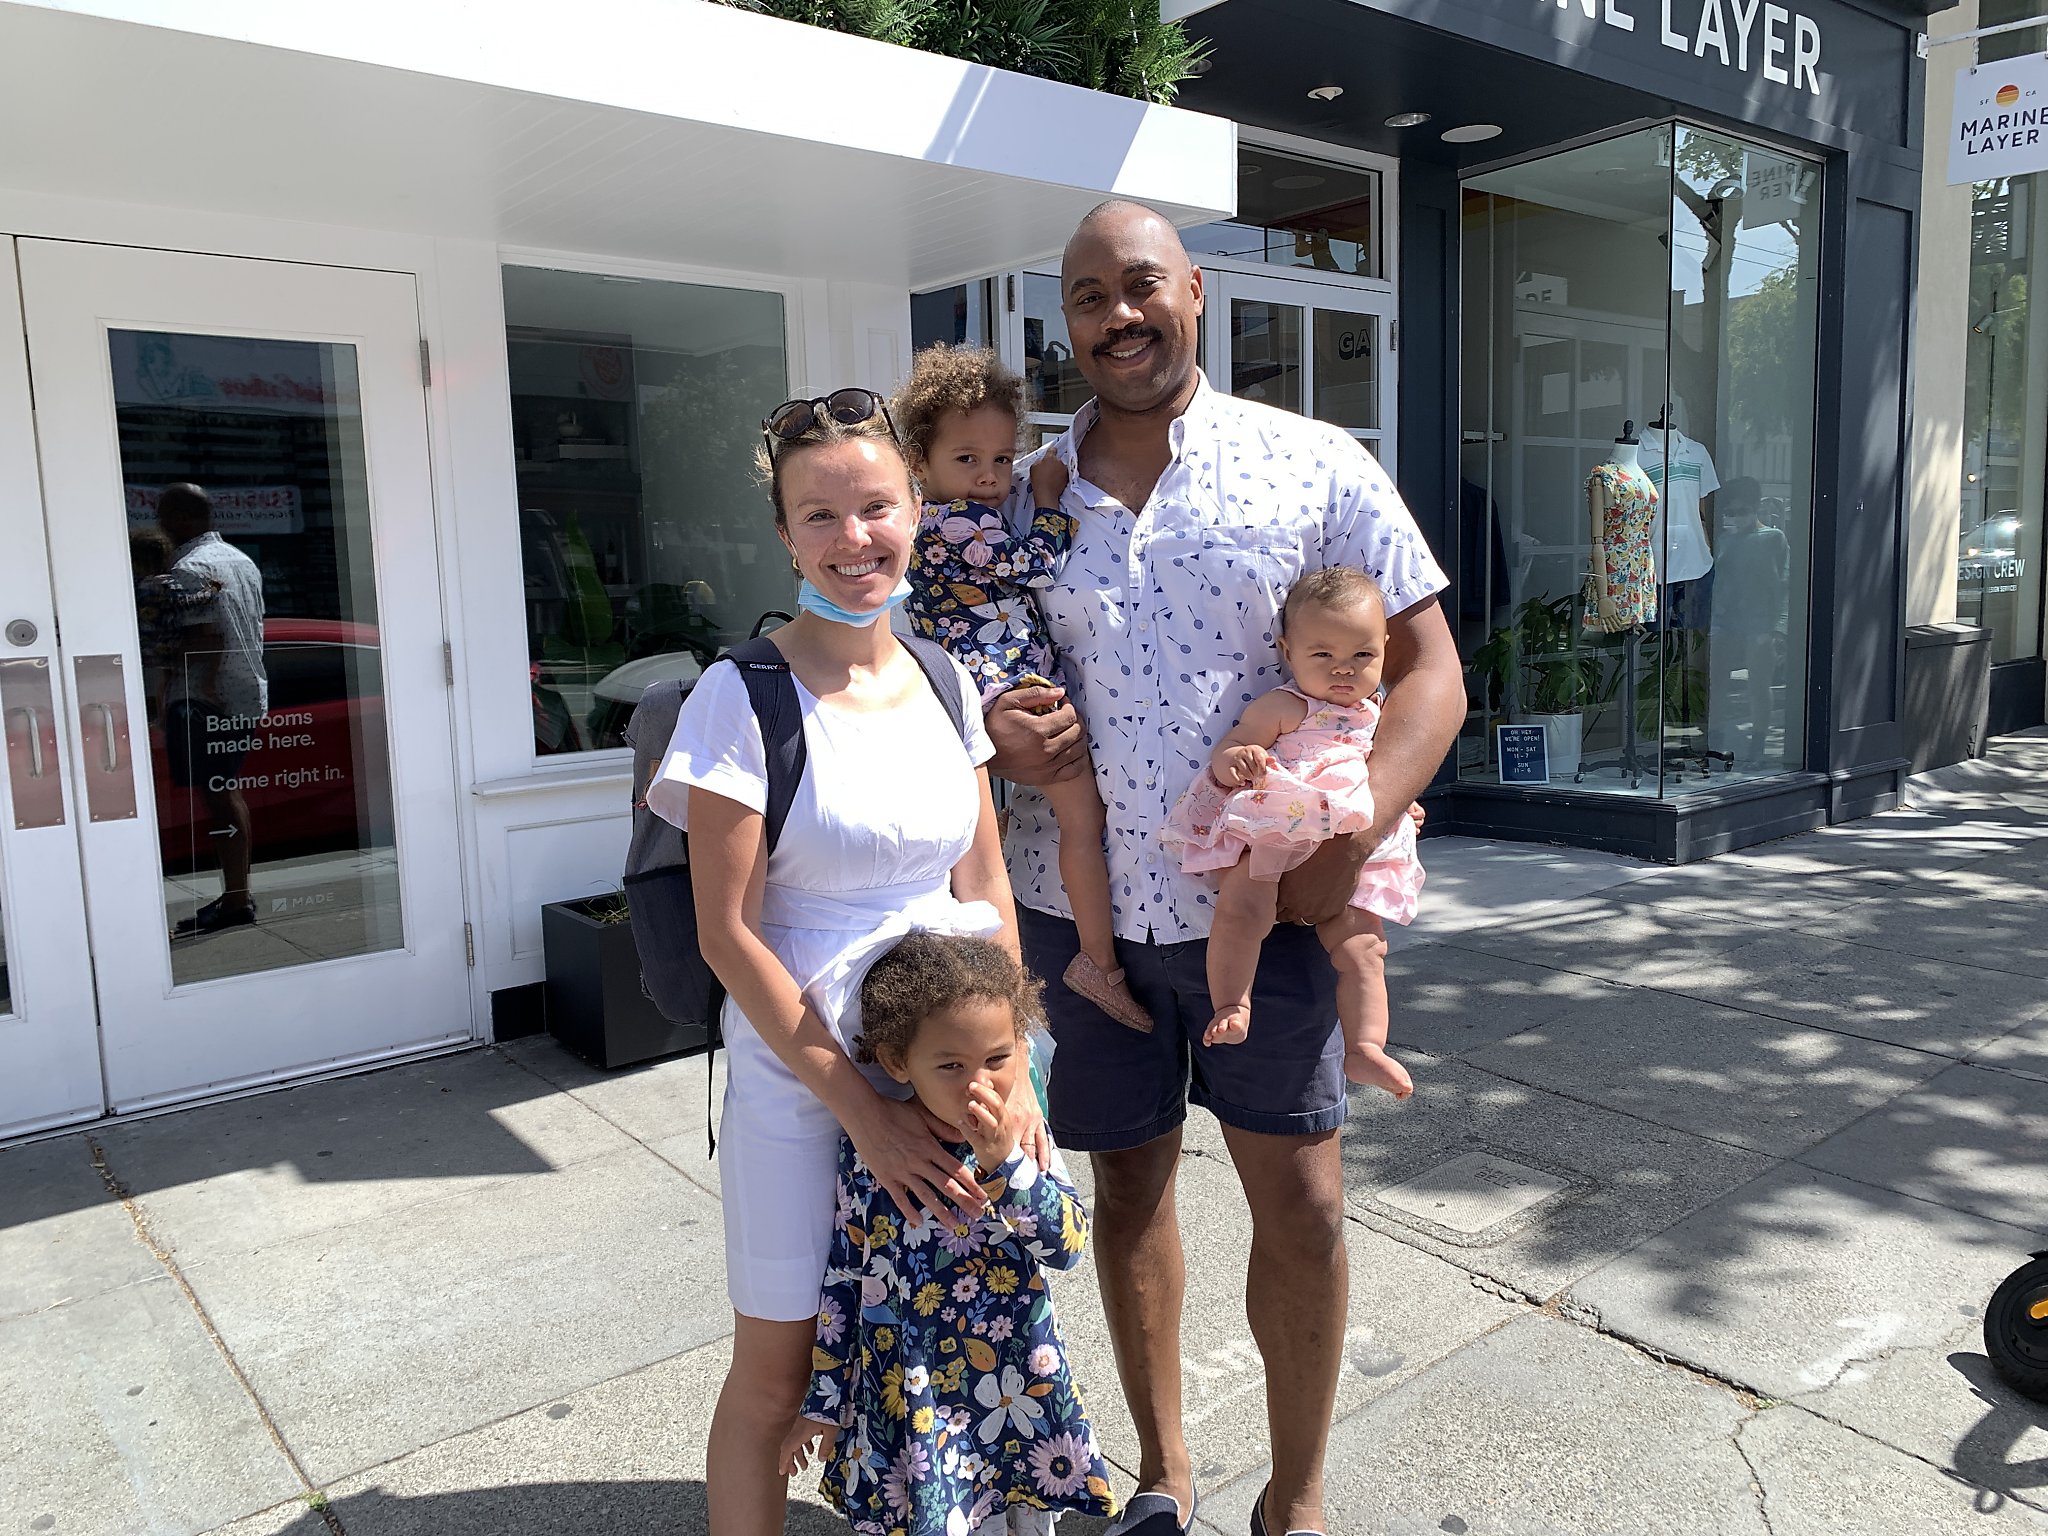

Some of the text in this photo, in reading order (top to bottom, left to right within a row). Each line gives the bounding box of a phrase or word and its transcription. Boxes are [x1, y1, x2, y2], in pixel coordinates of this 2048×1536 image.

[1661, 0, 1820, 96] LAYER
[1960, 107, 2048, 141] MARINE
[1967, 129, 2039, 156] LAYER
[1994, 559, 2026, 579] CREW
[206, 712, 313, 732] Bathrooms
[206, 733, 316, 754] made here.
[208, 765, 345, 792] Come right in.
[292, 892, 335, 908] MADE
[1474, 1171, 1510, 1189] BELL
